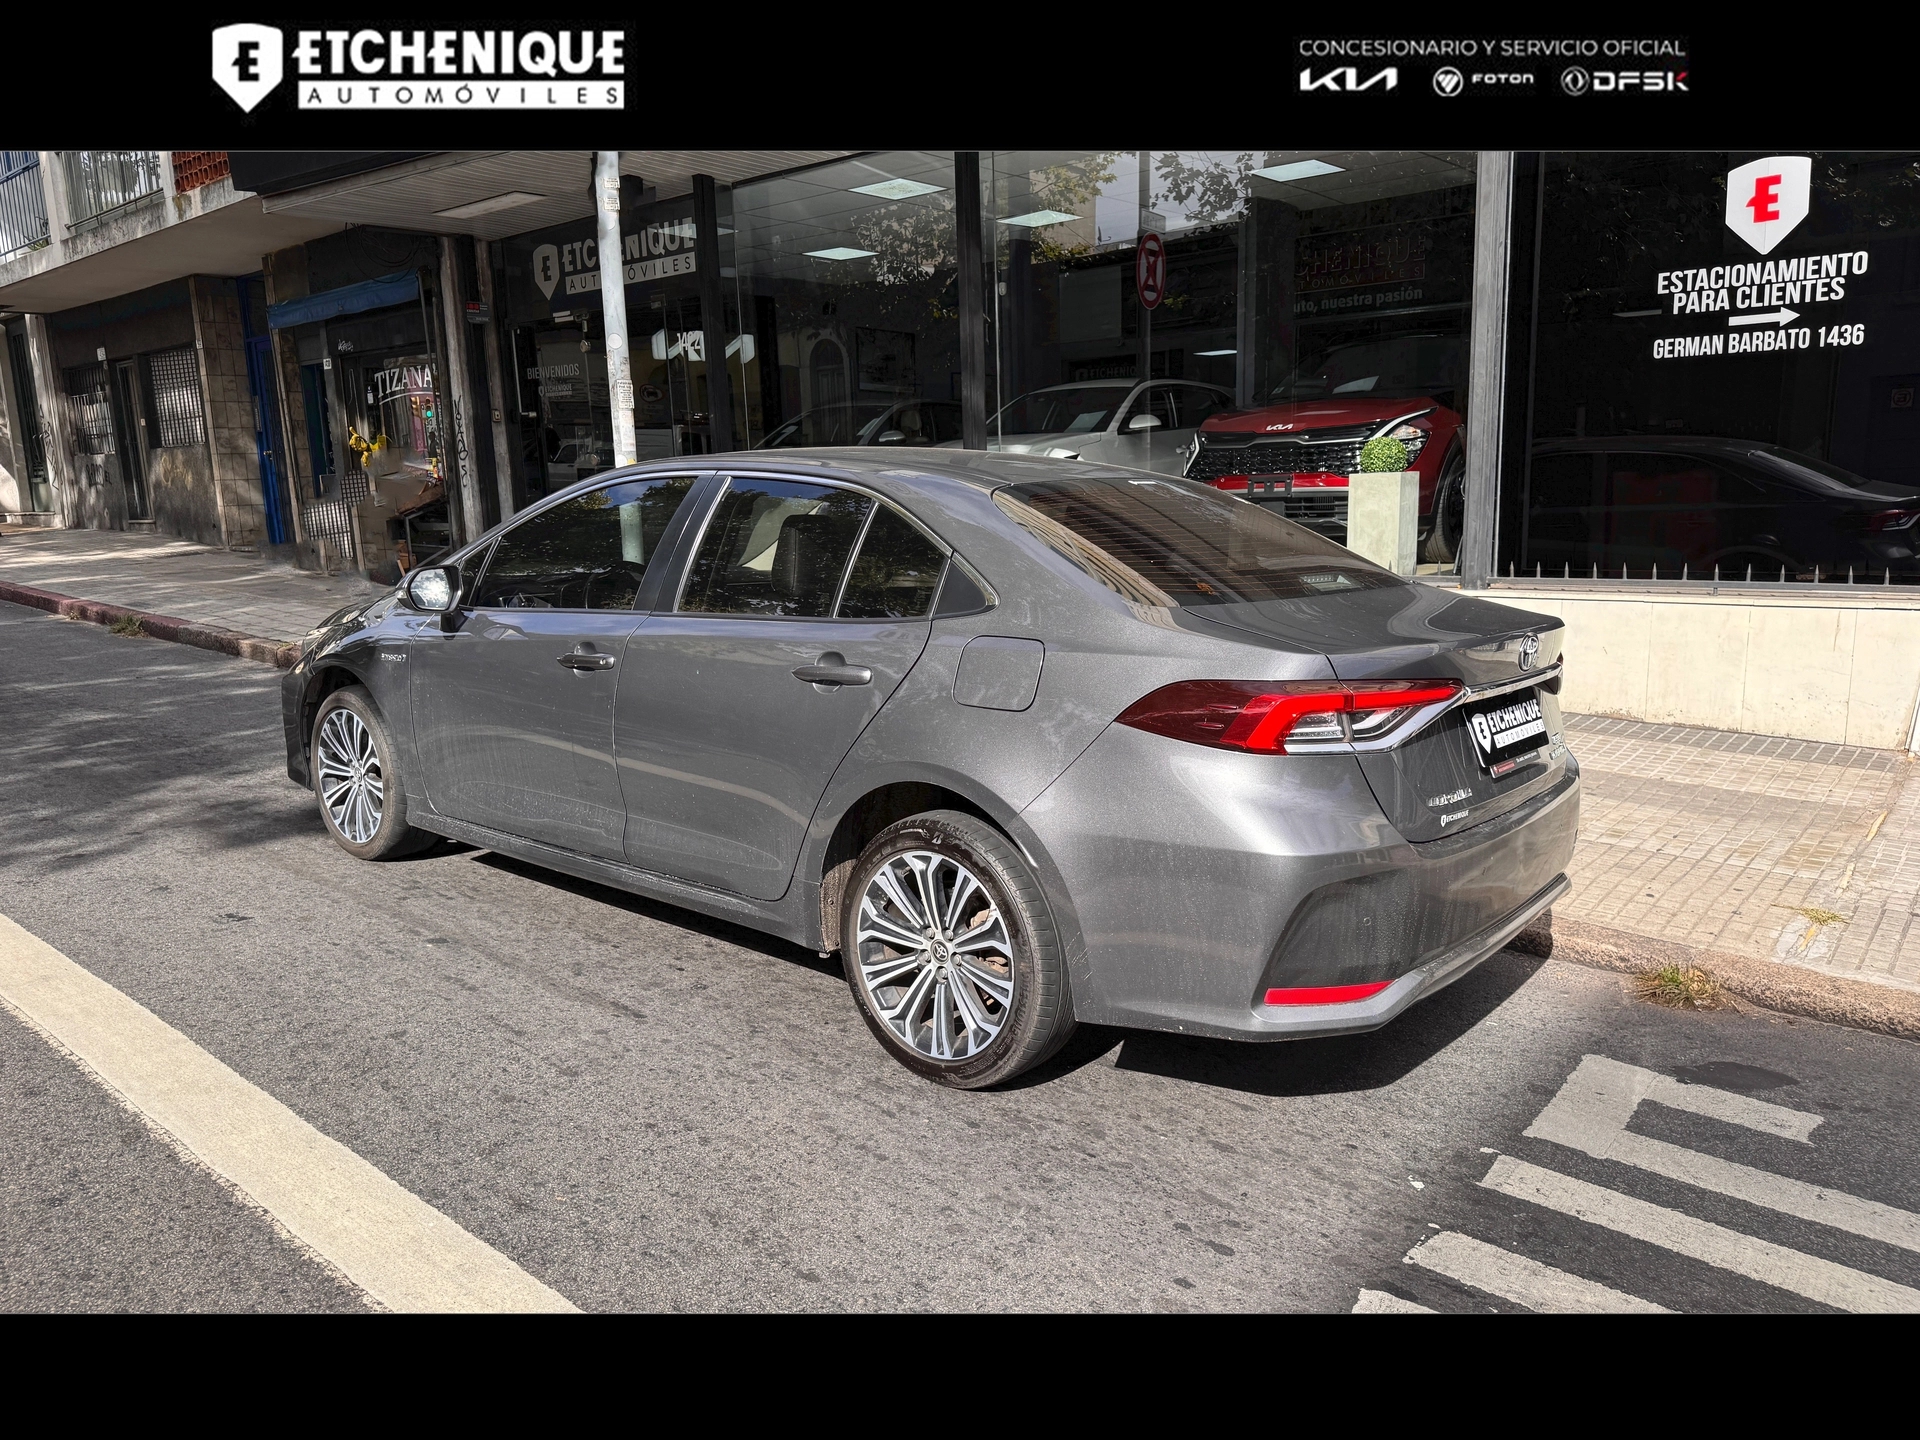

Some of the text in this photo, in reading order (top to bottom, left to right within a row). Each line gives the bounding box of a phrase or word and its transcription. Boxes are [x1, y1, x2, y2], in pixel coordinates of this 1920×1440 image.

[562, 217, 695, 273] ETCNIQUE
[569, 256, 692, 292] AUTÓVILES
[1657, 251, 1869, 295] ESTACIONAMIENTO
[1321, 293, 1373, 310] nuestra
[1375, 286, 1423, 307] pasión
[1672, 277, 1846, 315] PARA CLIENTES
[1653, 323, 1866, 359] GERMAN BARBATO 1436
[526, 363, 580, 380] BIENVENIDOS
[1486, 698, 1542, 734] ETCHENIQUE
